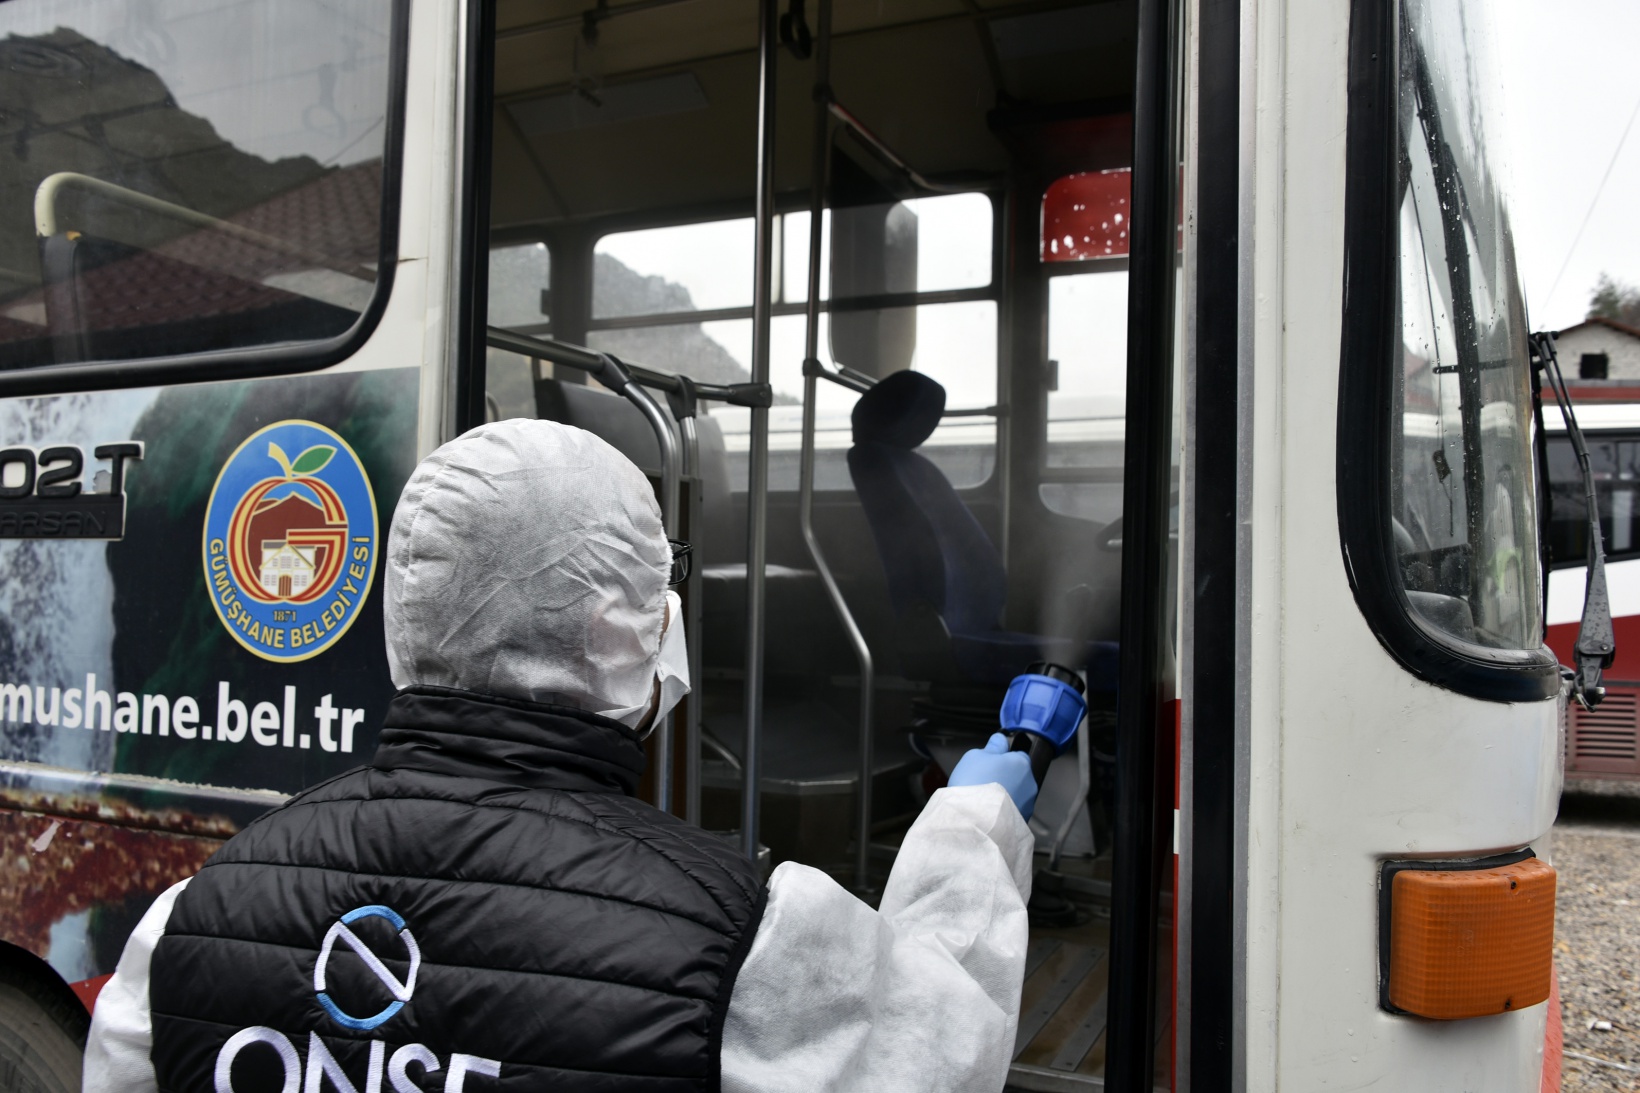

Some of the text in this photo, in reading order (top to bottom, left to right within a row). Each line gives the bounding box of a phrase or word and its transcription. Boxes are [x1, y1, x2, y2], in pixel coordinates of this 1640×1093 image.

[209, 536, 371, 649] GÜMÜŞHANE BELEDİYESİ
[273, 610, 297, 622] 1871
[0, 673, 364, 753] mushane.bel.tr
